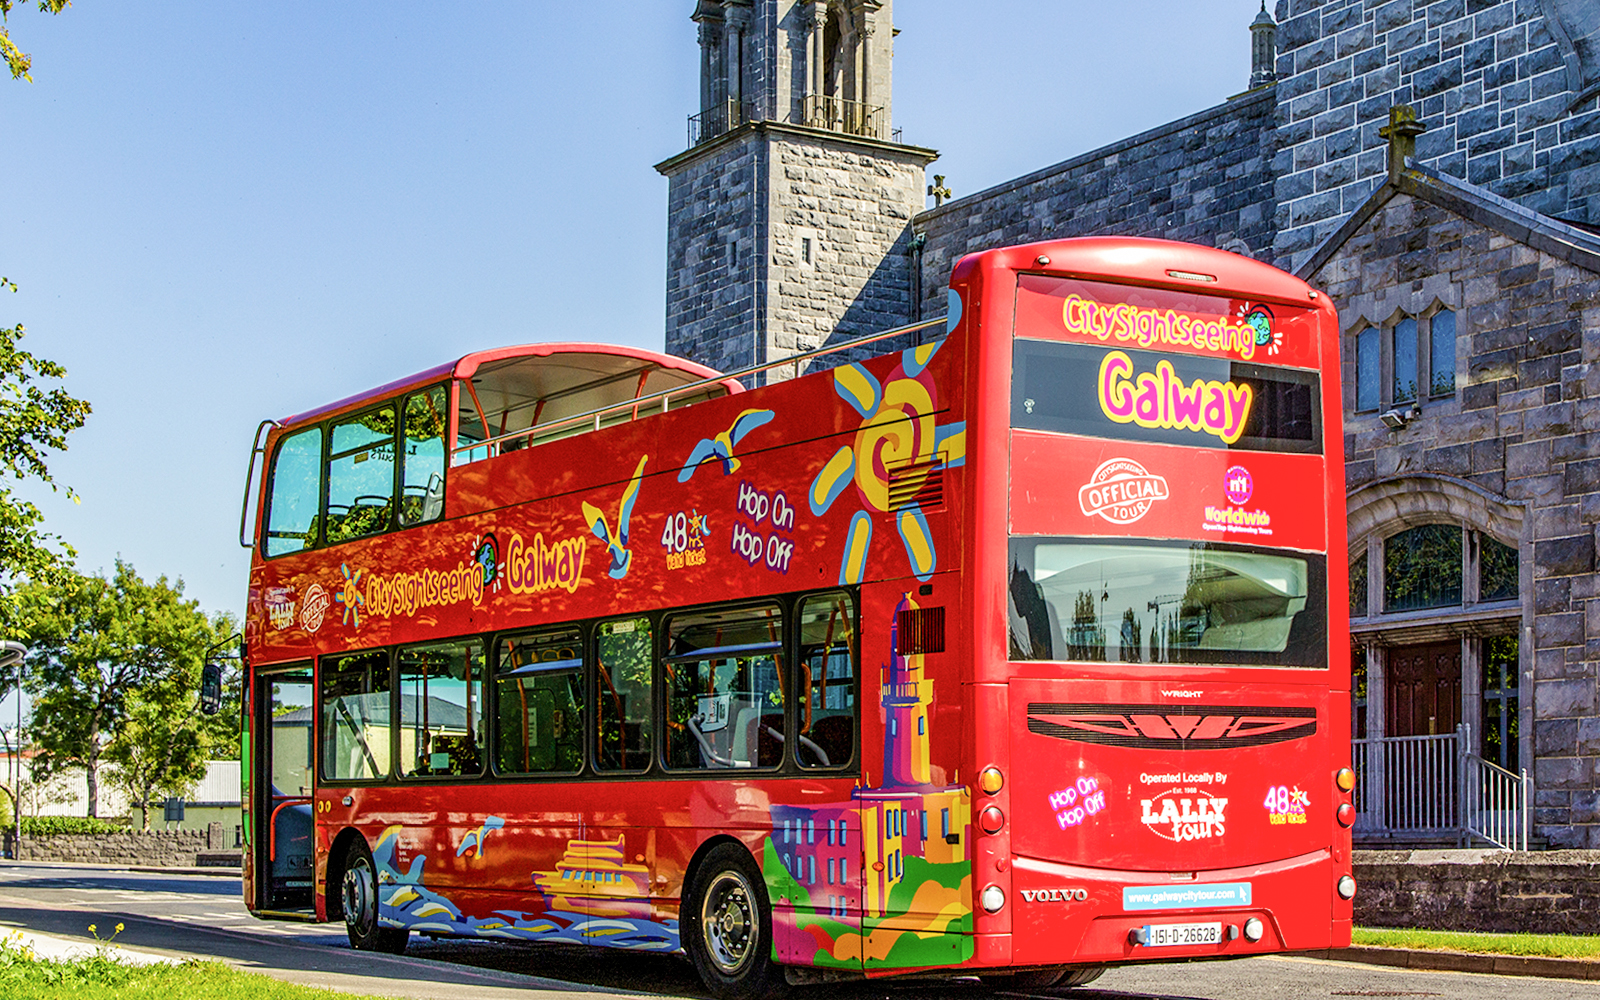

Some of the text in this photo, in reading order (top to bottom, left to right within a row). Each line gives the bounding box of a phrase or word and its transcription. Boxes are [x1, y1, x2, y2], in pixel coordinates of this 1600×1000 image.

[1063, 294, 1255, 360] CitySightseeing
[1098, 350, 1253, 444] Galway
[738, 481, 795, 531] Hop On
[1088, 480, 1163, 508] OFFICIAL
[1113, 501, 1146, 519] TOUR
[1204, 505, 1270, 526] Worldwide
[661, 511, 688, 553] 48
[731, 521, 795, 573] Hop Off
[507, 532, 586, 593] Galway
[366, 562, 484, 618] CitySightseeing
[269, 601, 296, 621] LALLY
[303, 595, 329, 624] OFFICIAL
[1160, 690, 1204, 698] WRIGHT
[1049, 776, 1098, 811] Hop On
[1140, 772, 1228, 786] Operated Locally By
[1056, 790, 1106, 830] Hop Off
[1140, 798, 1229, 825] LALLY
[1263, 785, 1289, 814] 48
[1171, 820, 1226, 842] tours
[1020, 887, 1088, 903] VOLVO
[1128, 889, 1236, 904] www.galwaycitytour.com
